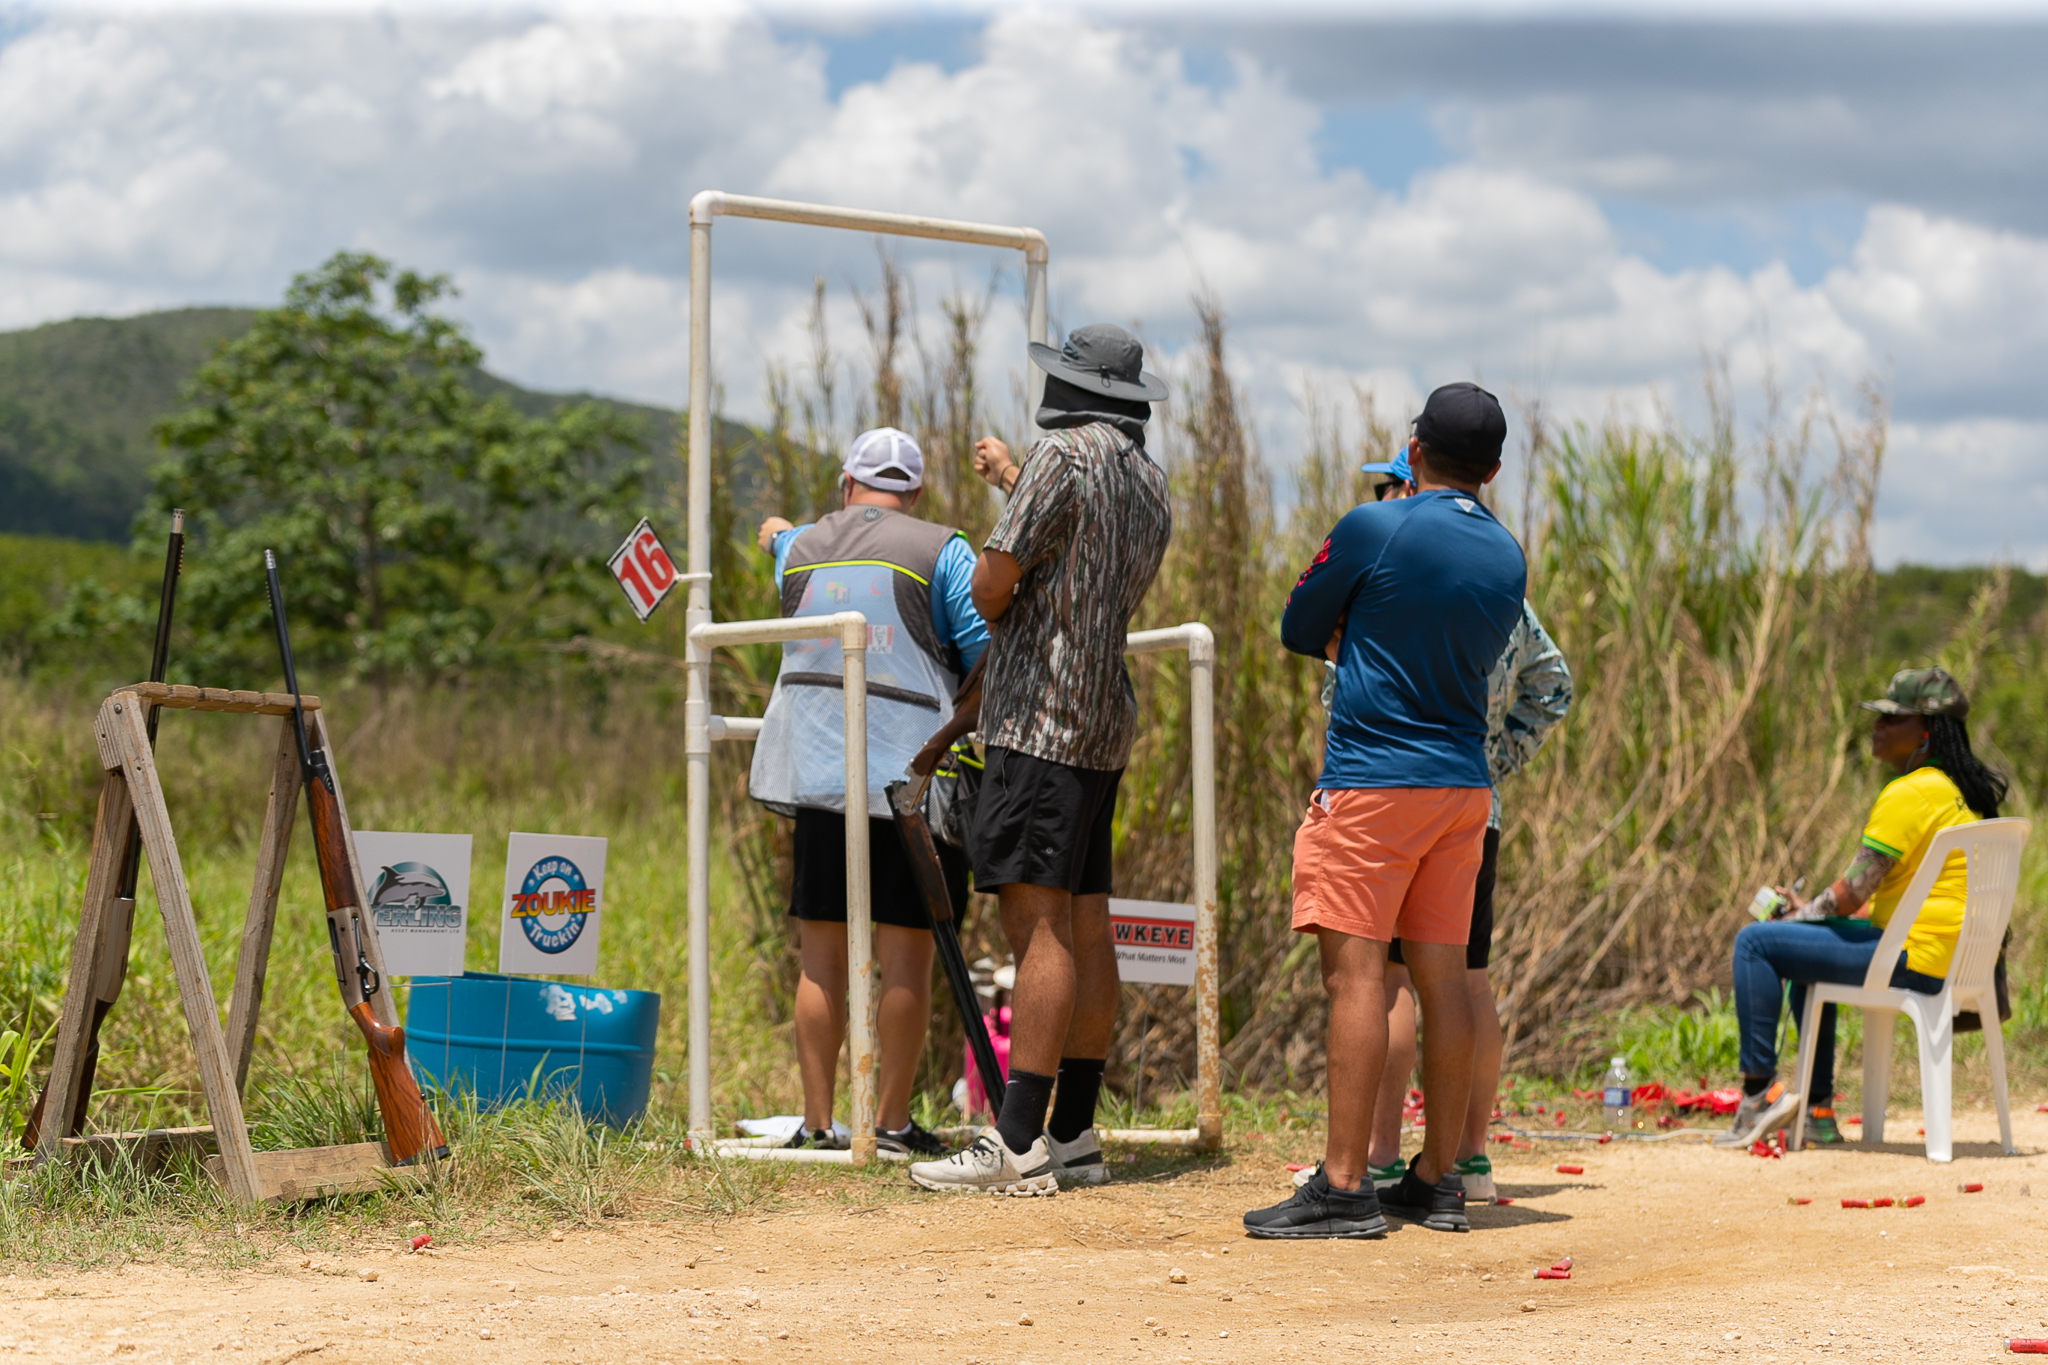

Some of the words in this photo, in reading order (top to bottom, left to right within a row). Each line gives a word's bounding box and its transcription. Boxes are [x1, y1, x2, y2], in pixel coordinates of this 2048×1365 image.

[619, 532, 674, 609] 16
[532, 860, 558, 881] Keep
[559, 861, 573, 876] on
[371, 903, 462, 928] ERLING
[510, 888, 596, 918] ZOUKIE
[529, 916, 581, 948] Truckin'
[1114, 923, 1190, 945] WKEYE
[1138, 952, 1166, 963] Matters
[1167, 954, 1187, 964] Most
